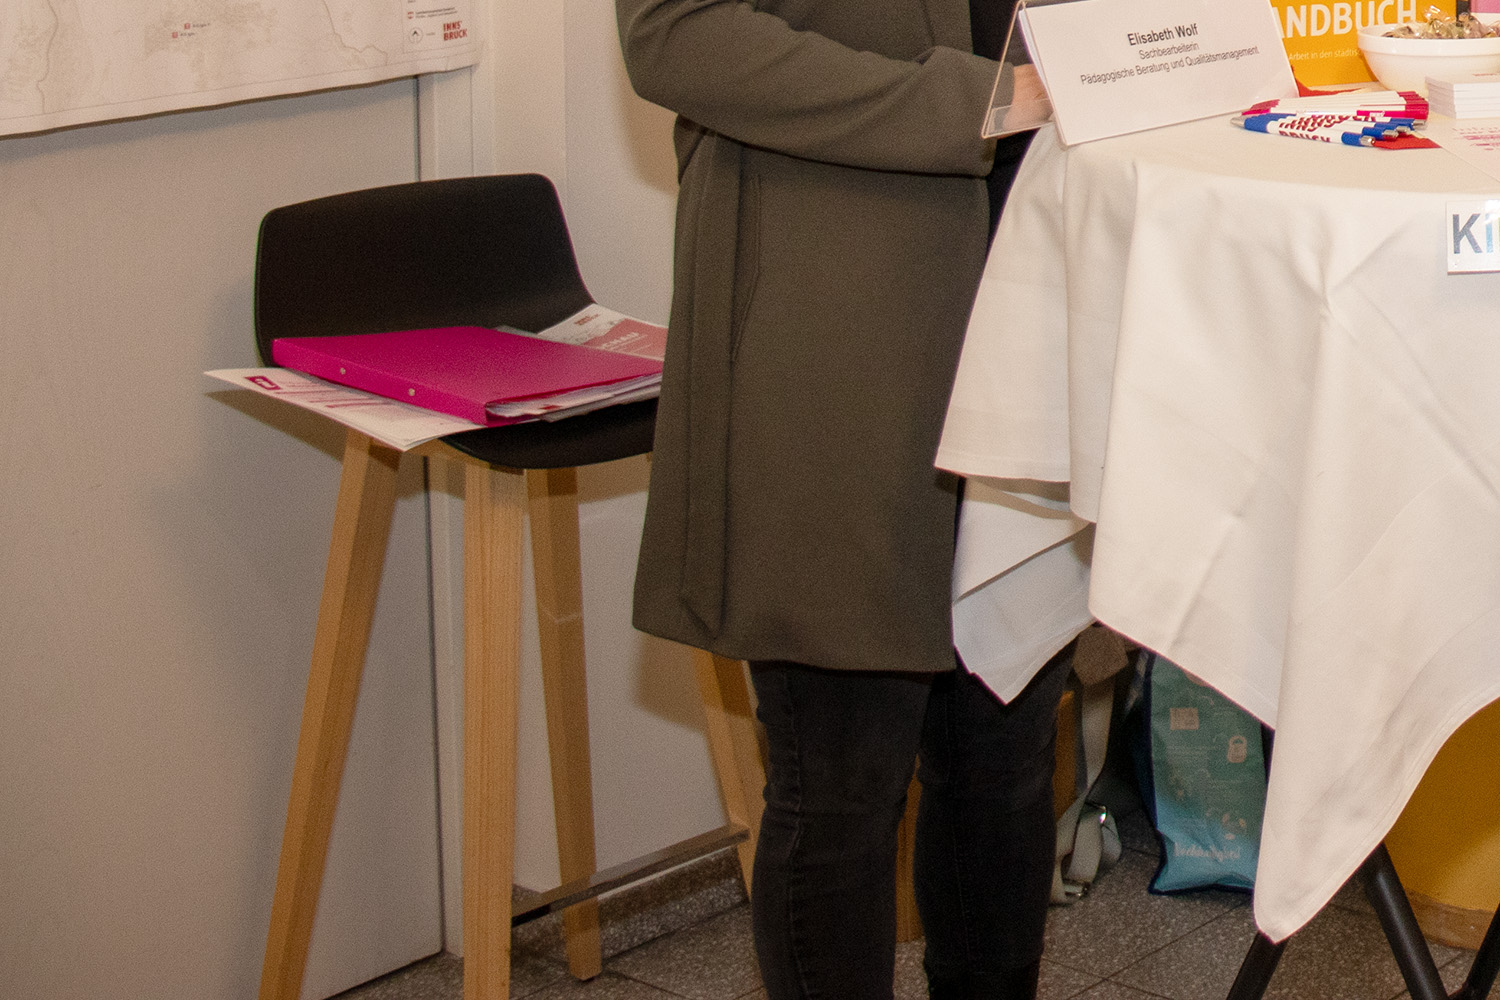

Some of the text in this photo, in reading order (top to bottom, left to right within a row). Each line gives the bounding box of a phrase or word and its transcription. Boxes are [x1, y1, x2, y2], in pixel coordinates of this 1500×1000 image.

[443, 29, 468, 41] BRUCK
[1127, 23, 1199, 47] Elisabeth Wolf
[1138, 42, 1200, 60] Sachbearbeiterin
[1334, 48, 1360, 57] städtis
[1080, 45, 1260, 86] Pädagogische Beratung und Qualitätsmanagement
